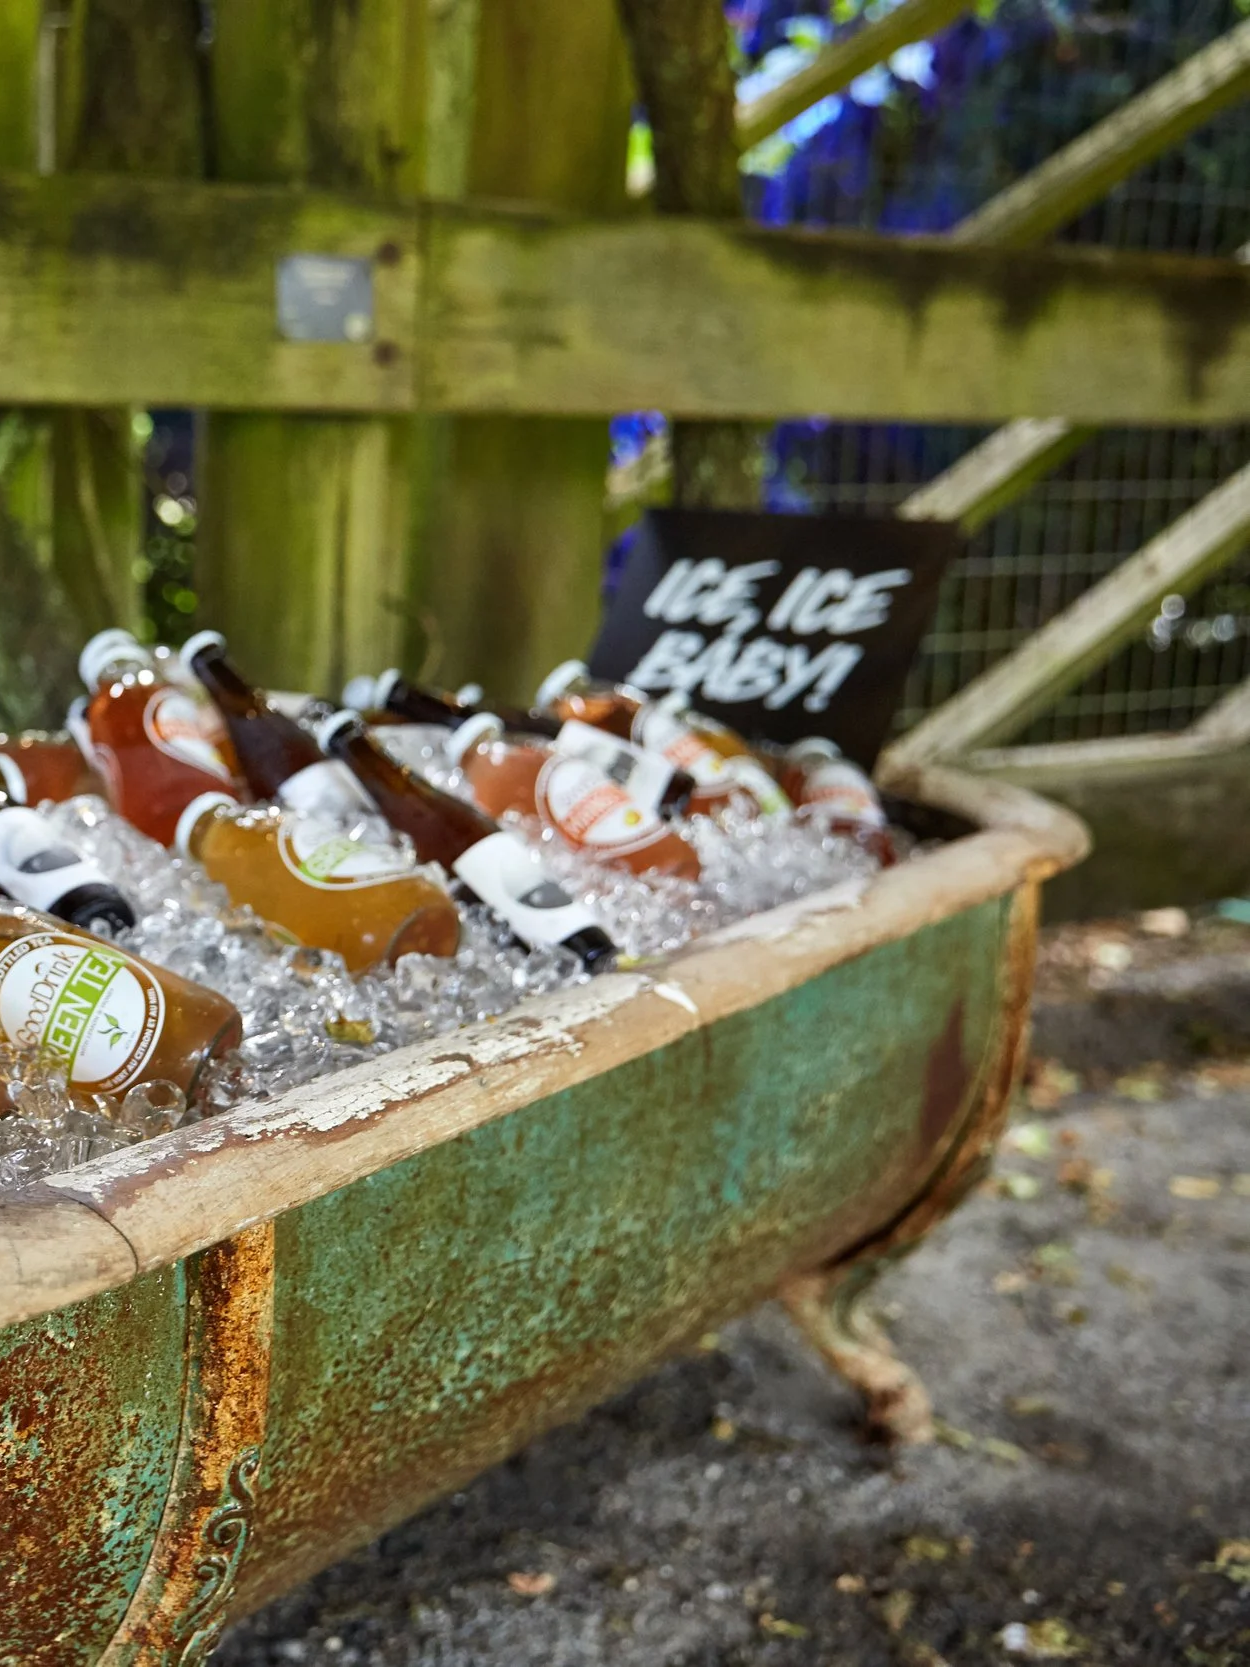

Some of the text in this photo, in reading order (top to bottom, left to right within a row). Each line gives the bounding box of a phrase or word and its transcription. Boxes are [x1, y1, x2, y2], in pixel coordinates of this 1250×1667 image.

[643, 557, 913, 636] ICE, ICE
[624, 629, 864, 713] BABY!
[72, 949, 124, 990] TEA
